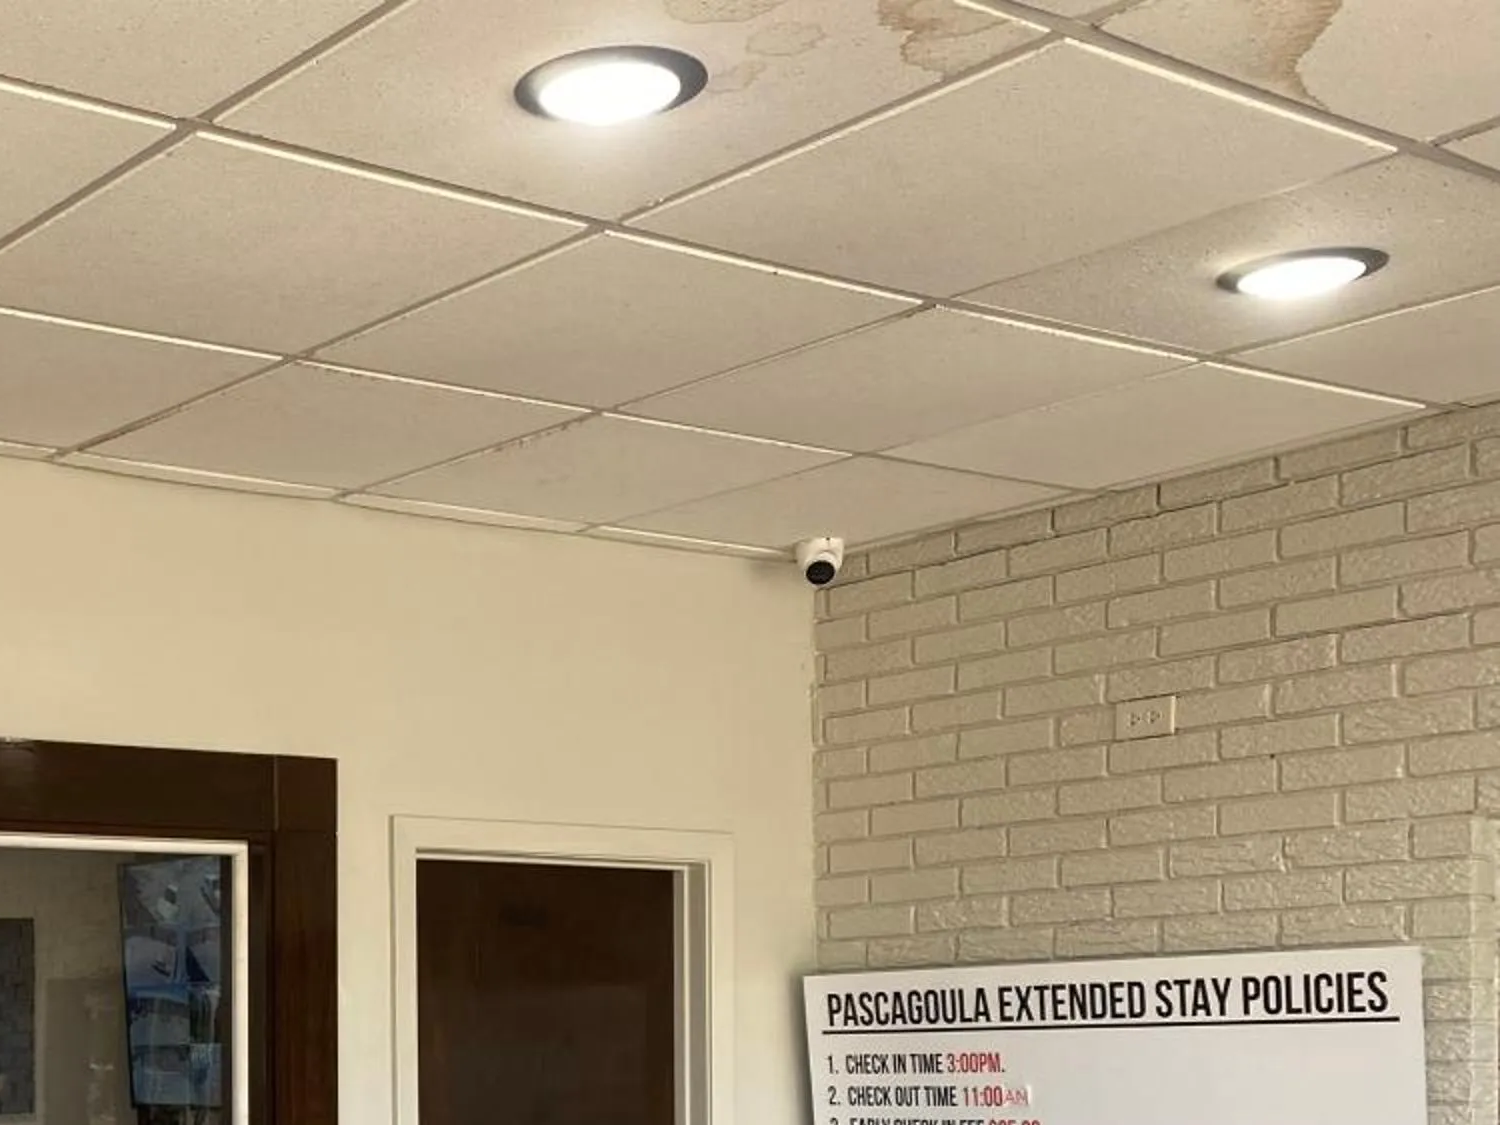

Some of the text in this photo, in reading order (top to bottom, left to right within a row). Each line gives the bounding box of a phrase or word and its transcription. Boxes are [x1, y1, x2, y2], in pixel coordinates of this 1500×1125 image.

[826, 969, 1389, 1027] PASCAGOULA EXTENDED STAY POLICIES
[844, 1053, 890, 1075] CHECK
[891, 1053, 909, 1074] IN
[908, 1052, 944, 1074] TIME
[846, 1085, 892, 1107] CHECK
[893, 1085, 922, 1107] OUT
[923, 1085, 958, 1108] TIME
